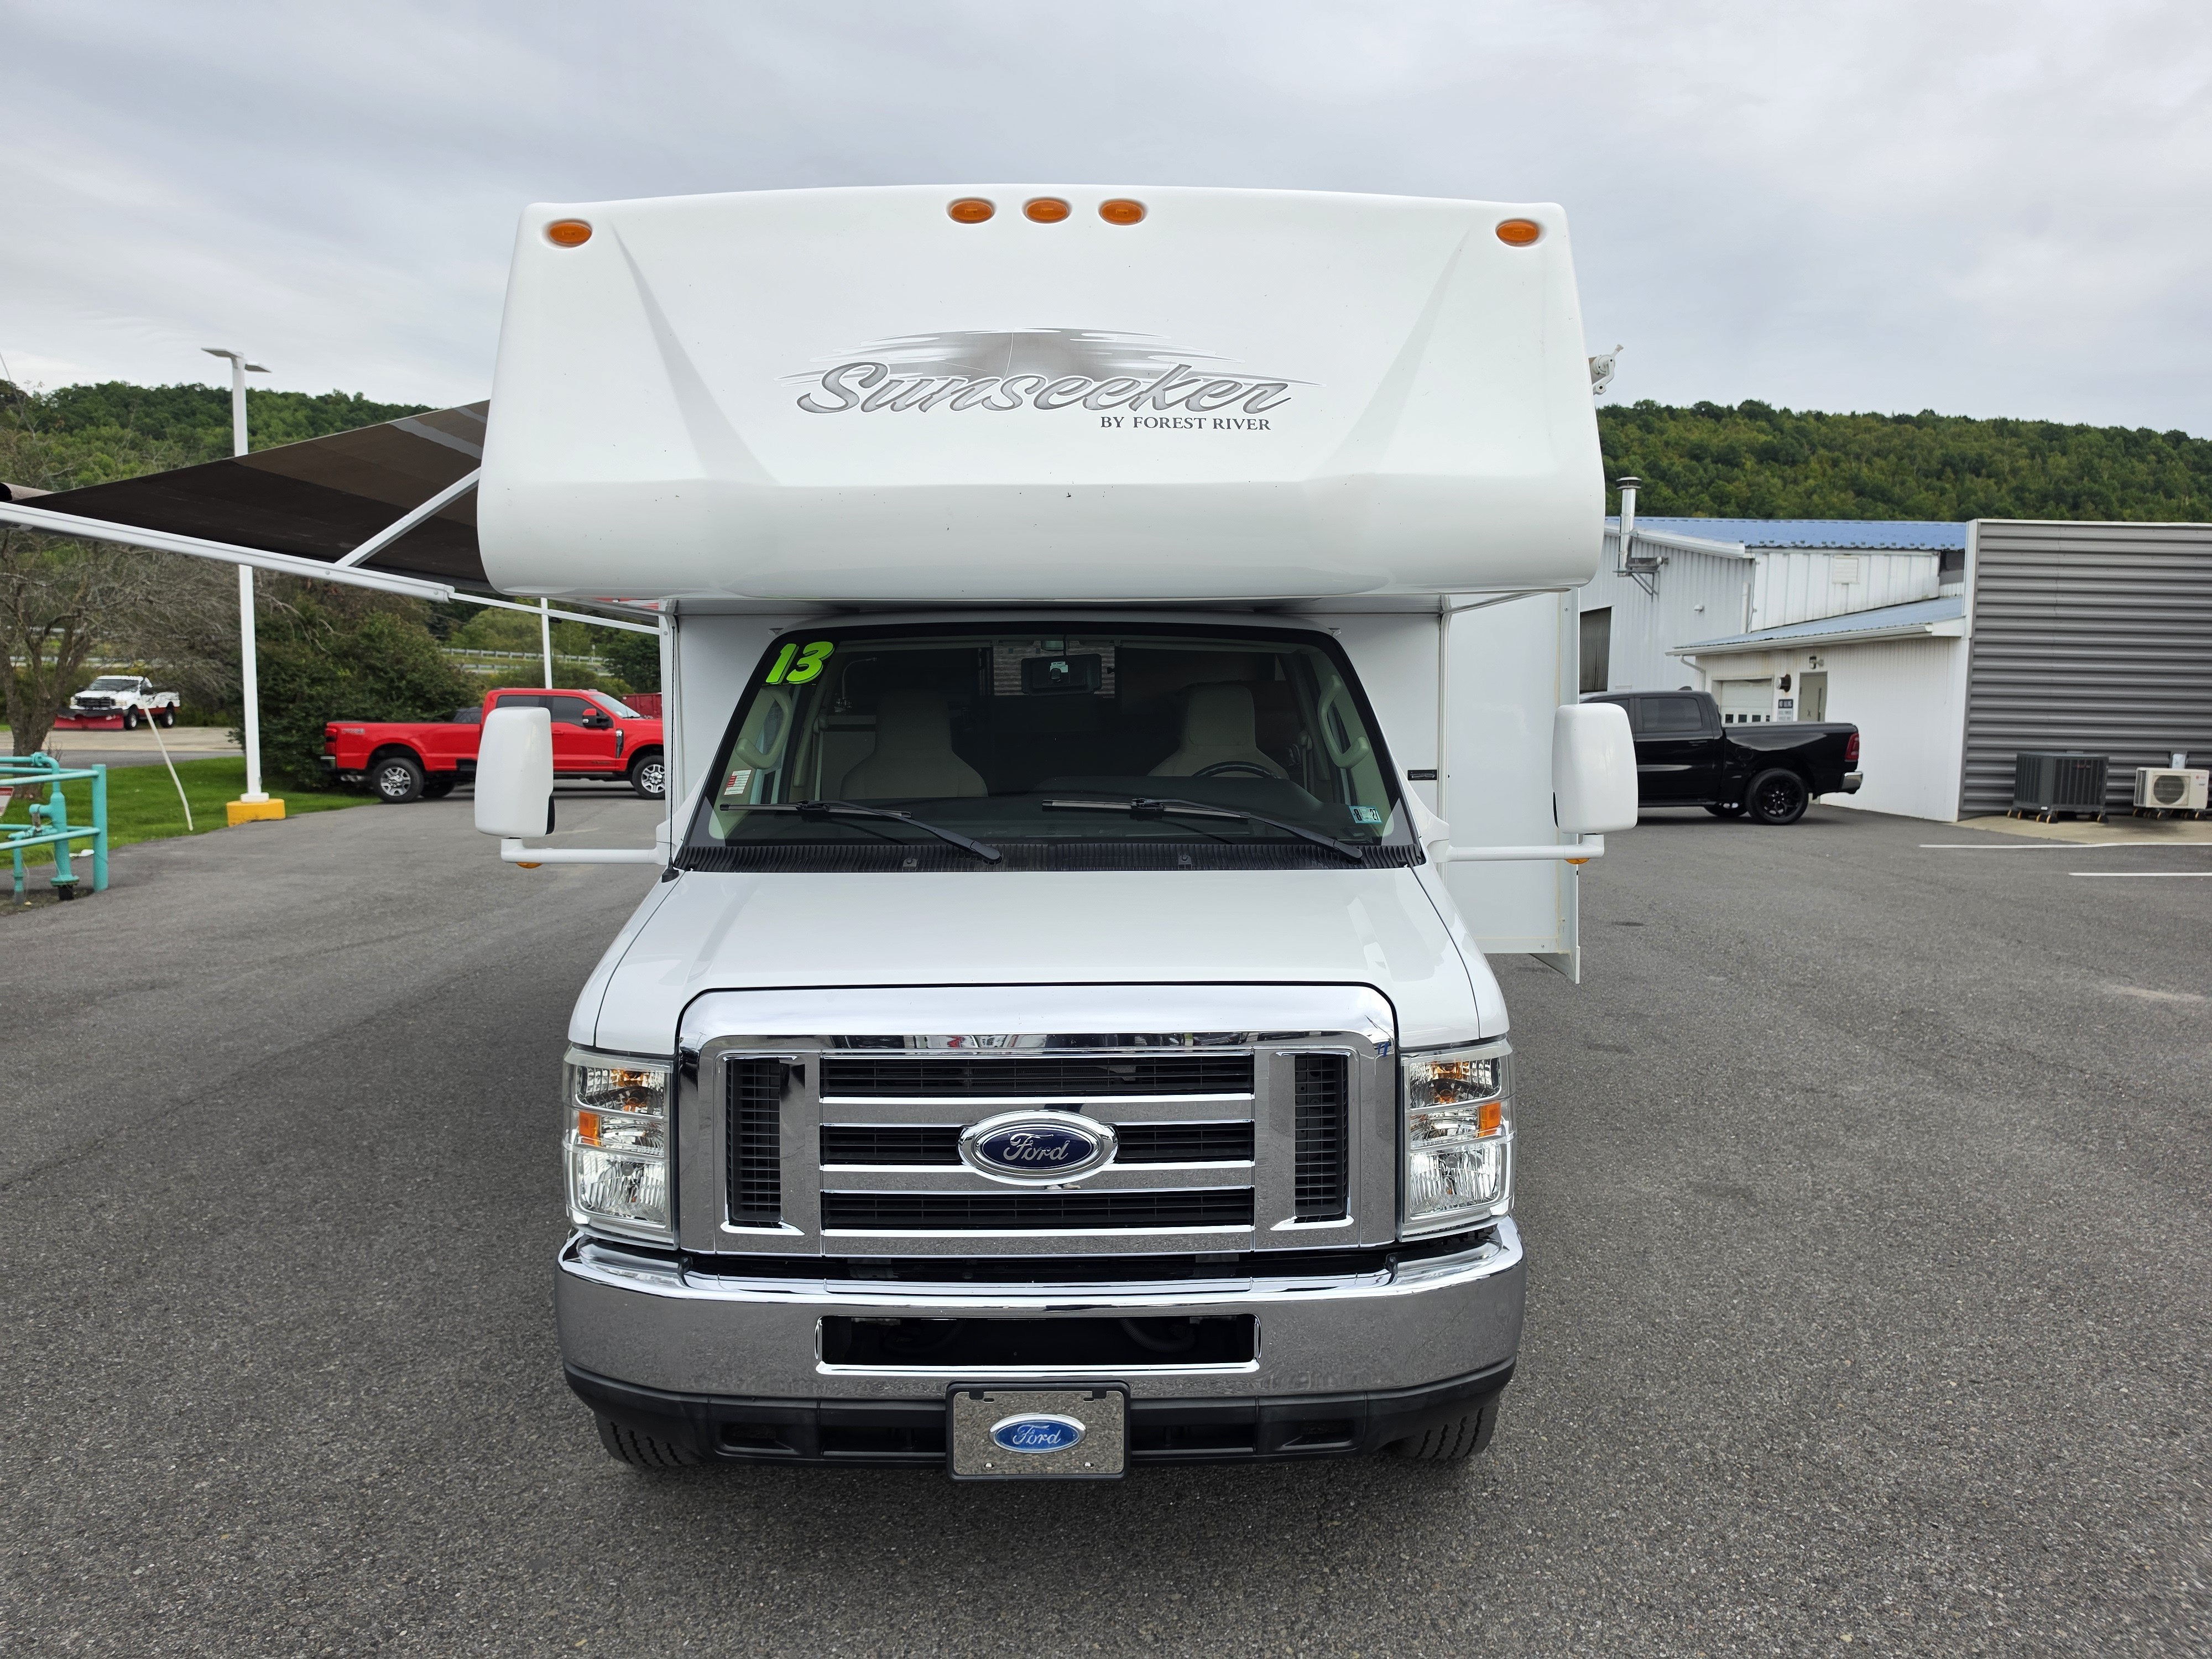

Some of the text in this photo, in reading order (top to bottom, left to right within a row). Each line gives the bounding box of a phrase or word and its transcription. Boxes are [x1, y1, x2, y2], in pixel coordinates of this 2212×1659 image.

[796, 362, 1292, 414] Sunseeker
[1100, 416, 1271, 430] BY FOREST RIVER
[765, 641, 835, 685] 13
[1369, 808, 1379, 821] 27
[1003, 1133, 1071, 1161] Ford
[1013, 1424, 1061, 1445] Ford
